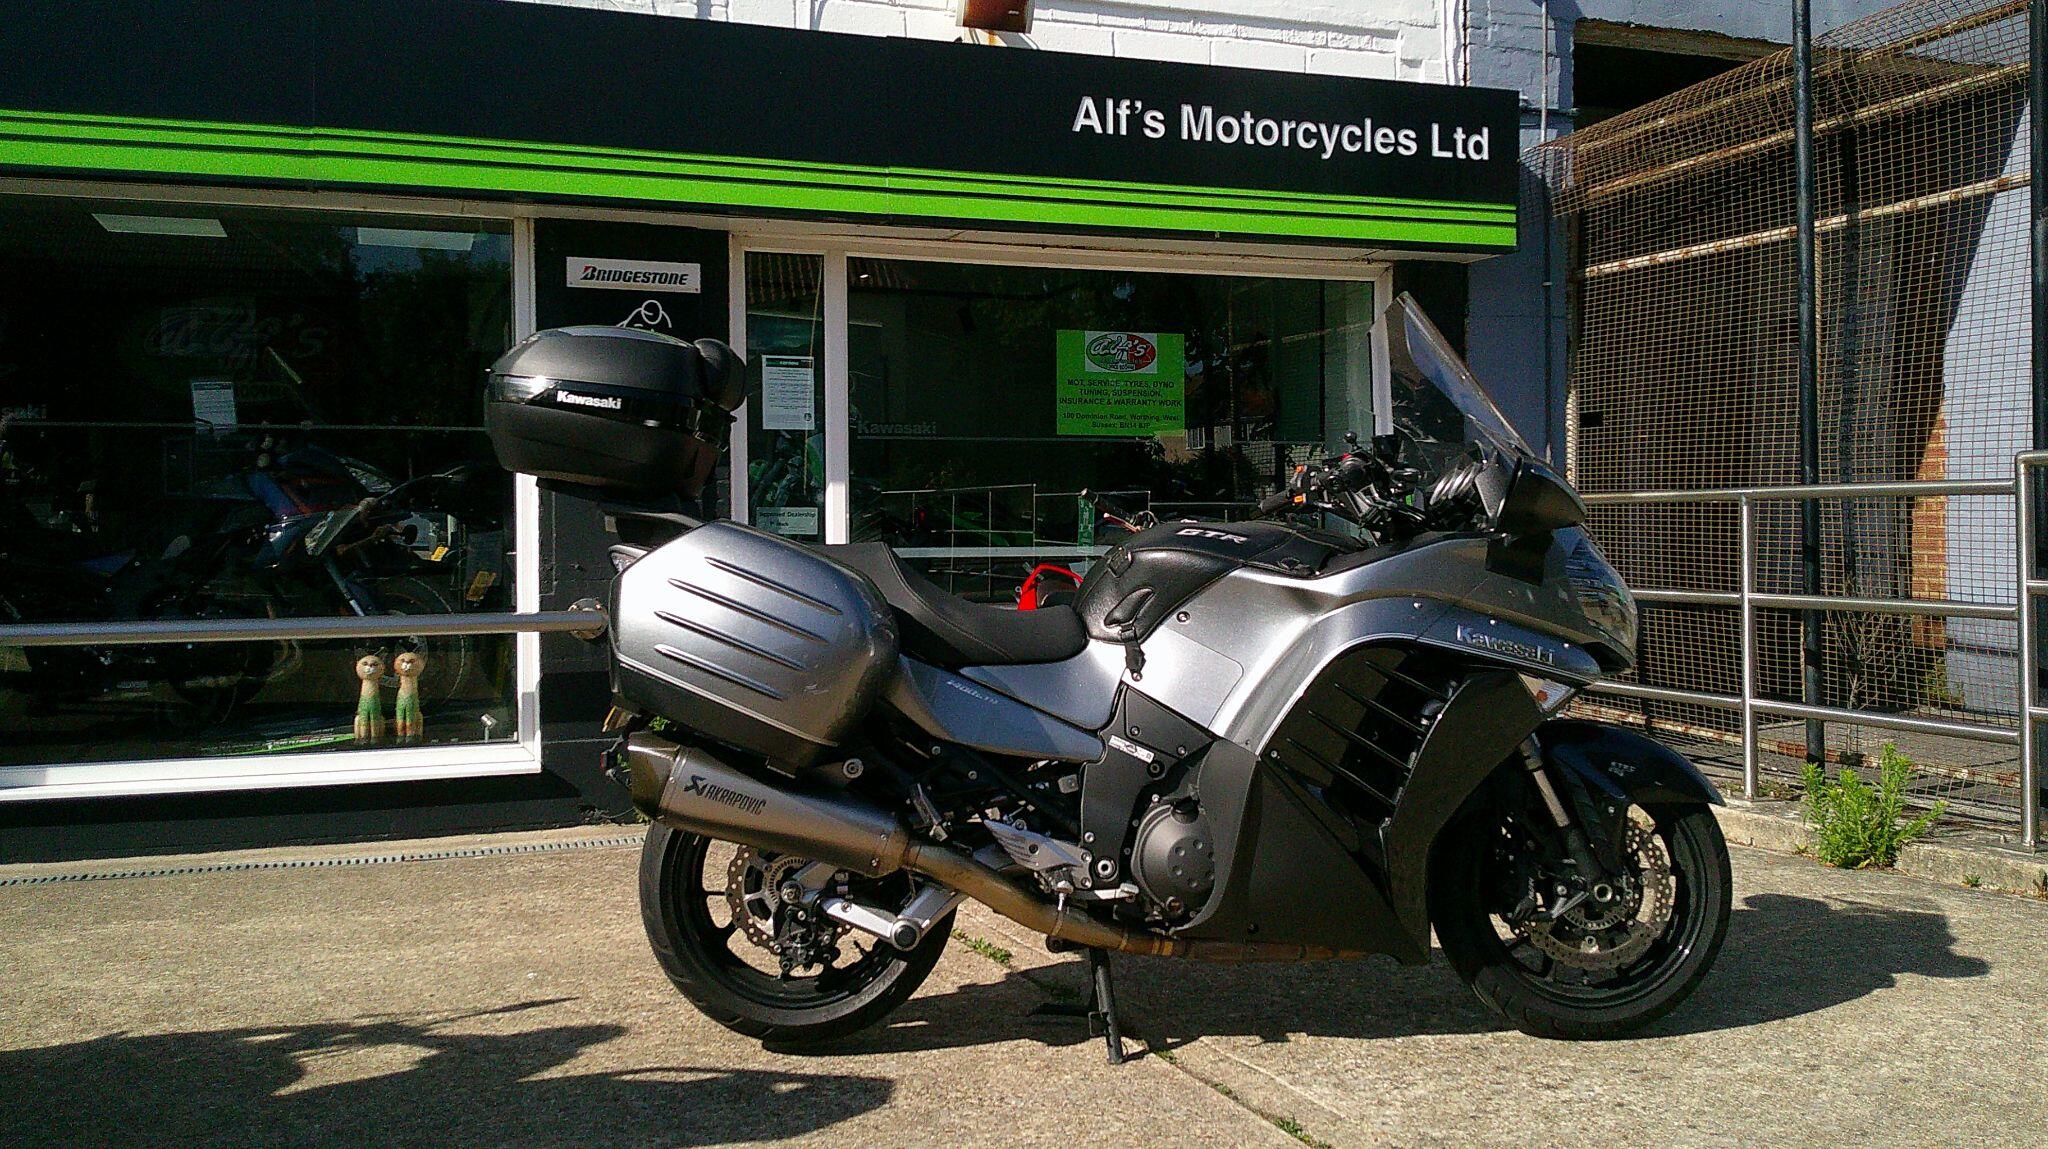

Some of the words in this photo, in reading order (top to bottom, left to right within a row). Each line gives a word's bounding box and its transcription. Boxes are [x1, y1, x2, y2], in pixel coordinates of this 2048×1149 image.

[1072, 95, 1166, 139] Alf's
[1180, 103, 1418, 160] Motorcycles
[1430, 122, 1491, 161] Ltd
[580, 264, 689, 286] BRIDGESTONE
[1152, 380, 1175, 388] DYNO
[556, 390, 623, 410] Kawasaki
[1112, 389, 1163, 398] SUSPENSION,
[1106, 398, 1112, 406] &
[1113, 398, 1157, 406] WARRANTY
[1158, 399, 1182, 407] WORK
[857, 419, 937, 435] Kawasaki
[1175, 528, 1249, 545] GTR
[1455, 624, 1556, 667] Kawasaki
